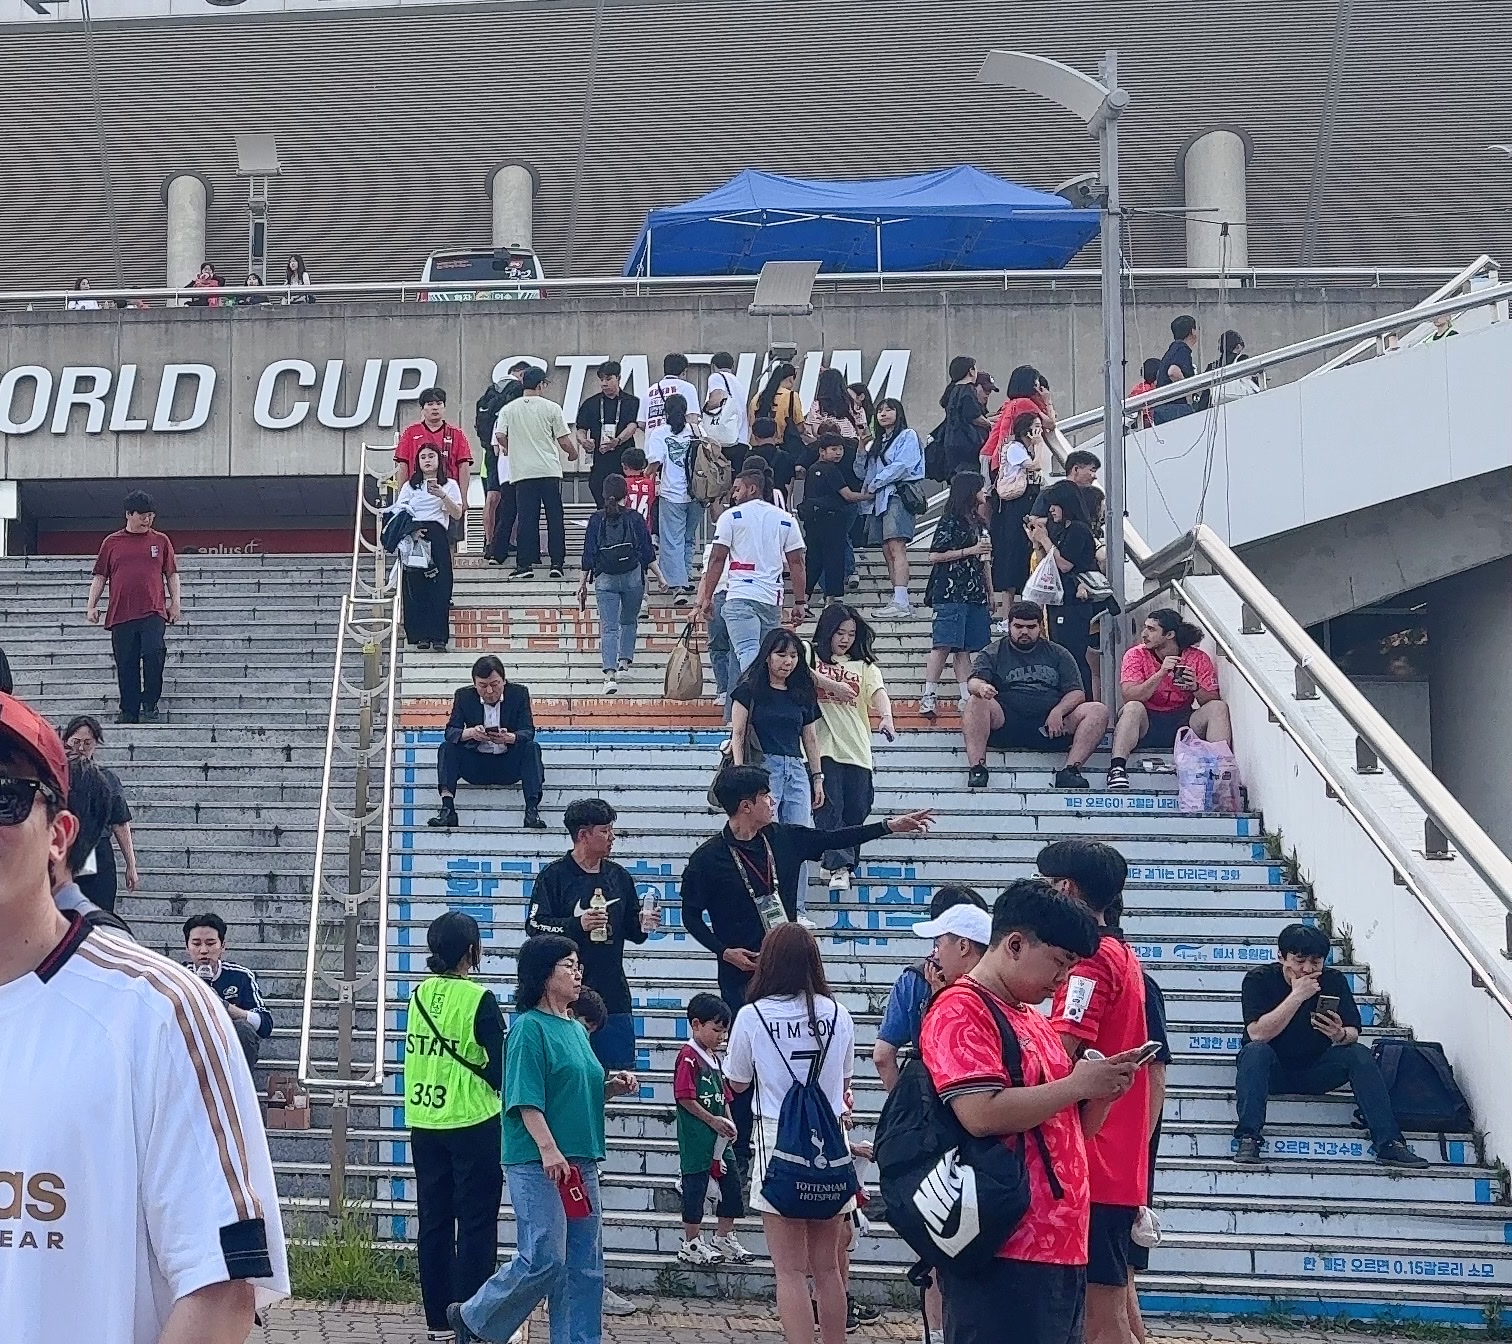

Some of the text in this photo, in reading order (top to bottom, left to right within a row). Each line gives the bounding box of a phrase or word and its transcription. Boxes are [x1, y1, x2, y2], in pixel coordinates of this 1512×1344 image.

[253, 357, 439, 431] CUP
[491, 349, 912, 425] TAIUM
[788, 1021, 801, 1038] M
[790, 1049, 823, 1087] 7
[410, 1083, 447, 1109] 353
[795, 1181, 847, 1193] TOTTENHAM
[799, 1192, 841, 1202] HOTSPUR
